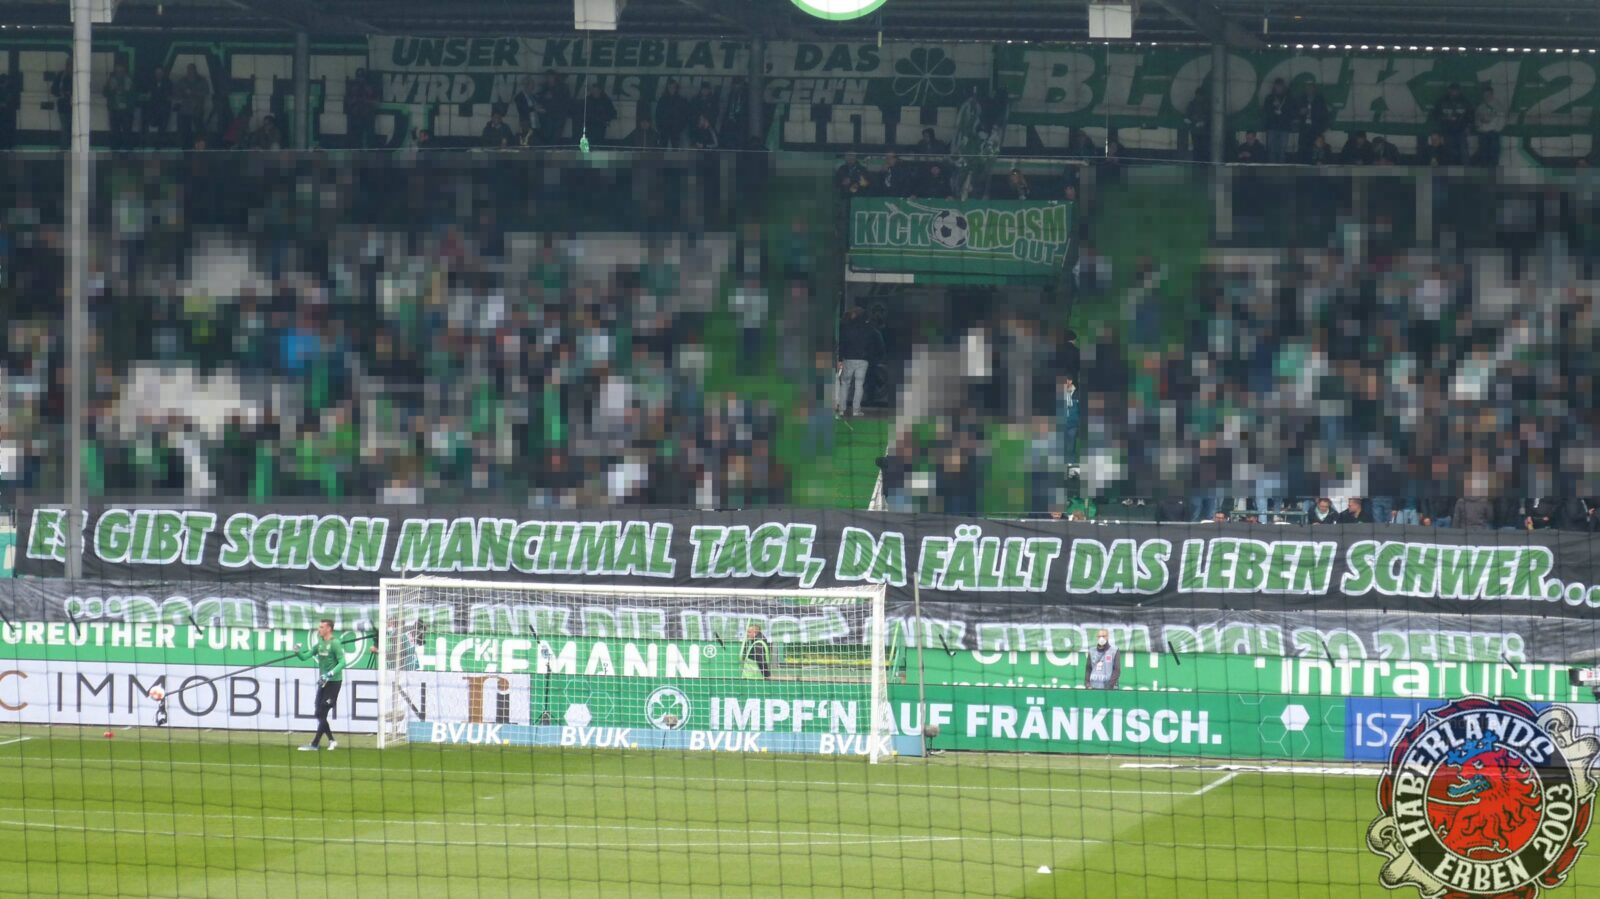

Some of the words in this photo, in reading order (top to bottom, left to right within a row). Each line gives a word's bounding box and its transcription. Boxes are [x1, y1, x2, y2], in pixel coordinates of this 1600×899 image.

[392, 38, 521, 67] UNSER
[794, 44, 881, 72] DAS
[382, 73, 476, 103] WIRD
[1022, 50, 1435, 123] BLOCK
[1474, 59, 1597, 127] 12
[854, 209, 934, 246] KICK
[965, 204, 1066, 250] RACISM
[94, 509, 217, 565] GIBT
[218, 512, 390, 571] SCHON
[391, 517, 676, 577] MANCHMAL
[689, 522, 826, 588] TAGE,
[834, 526, 907, 587] DA
[917, 524, 1062, 592] FÄLLT
[1066, 538, 1172, 594] DAS
[1177, 537, 1337, 594] LEBEN
[2, 621, 176, 648] GREUTHER
[431, 723, 510, 744] BVUK.
[966, 697, 1222, 744] FRÄNKISCH.
[560, 726, 638, 748] BVUK.
[689, 730, 767, 752] BVUK.
[819, 733, 898, 756] BVUK.
